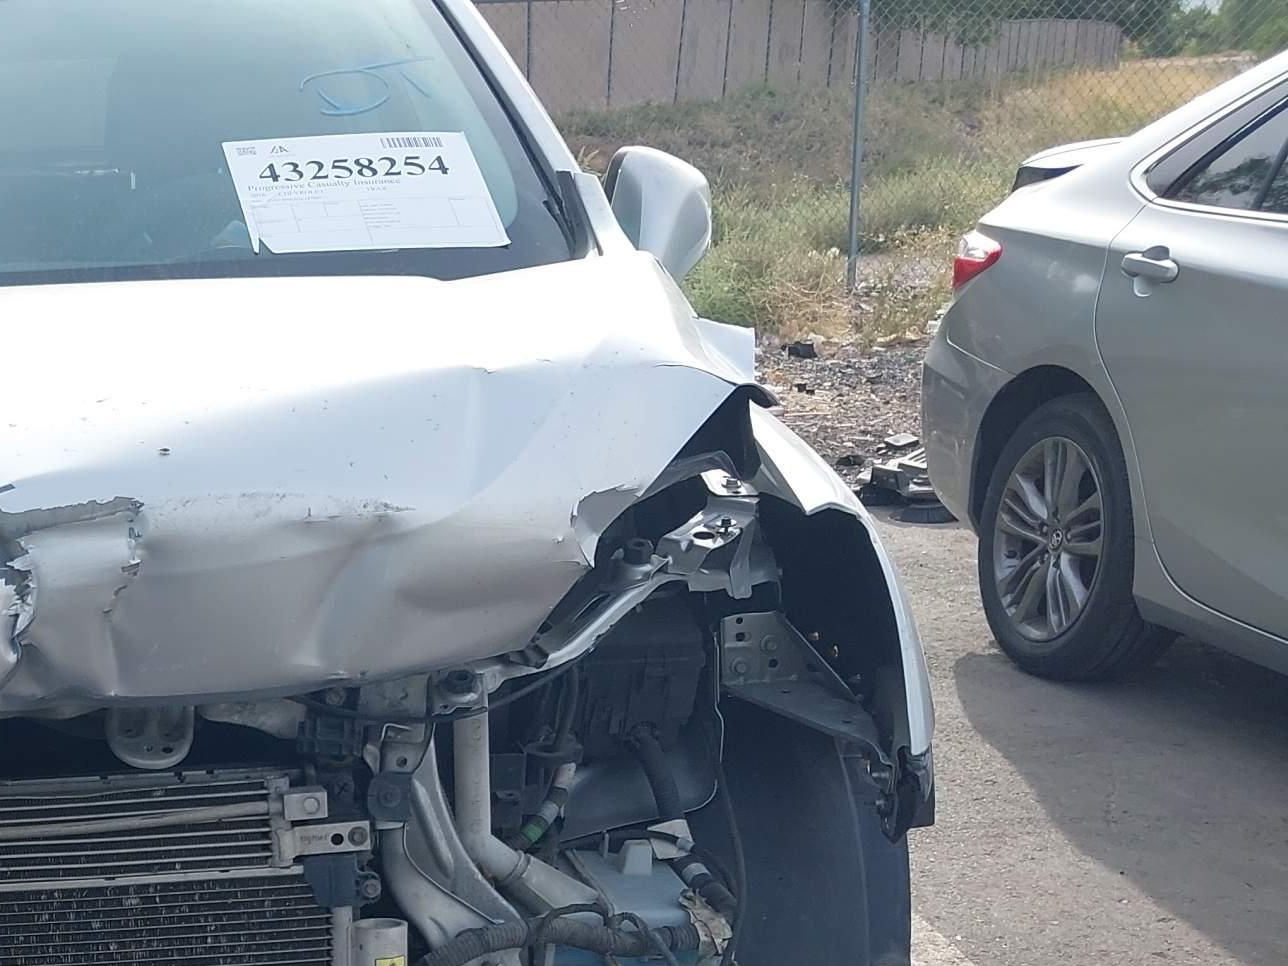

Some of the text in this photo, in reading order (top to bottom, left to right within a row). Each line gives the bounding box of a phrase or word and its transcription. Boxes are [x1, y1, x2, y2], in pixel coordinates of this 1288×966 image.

[259, 154, 450, 183] 43258254
[247, 177, 401, 193] Progressive Casualty Insurance
